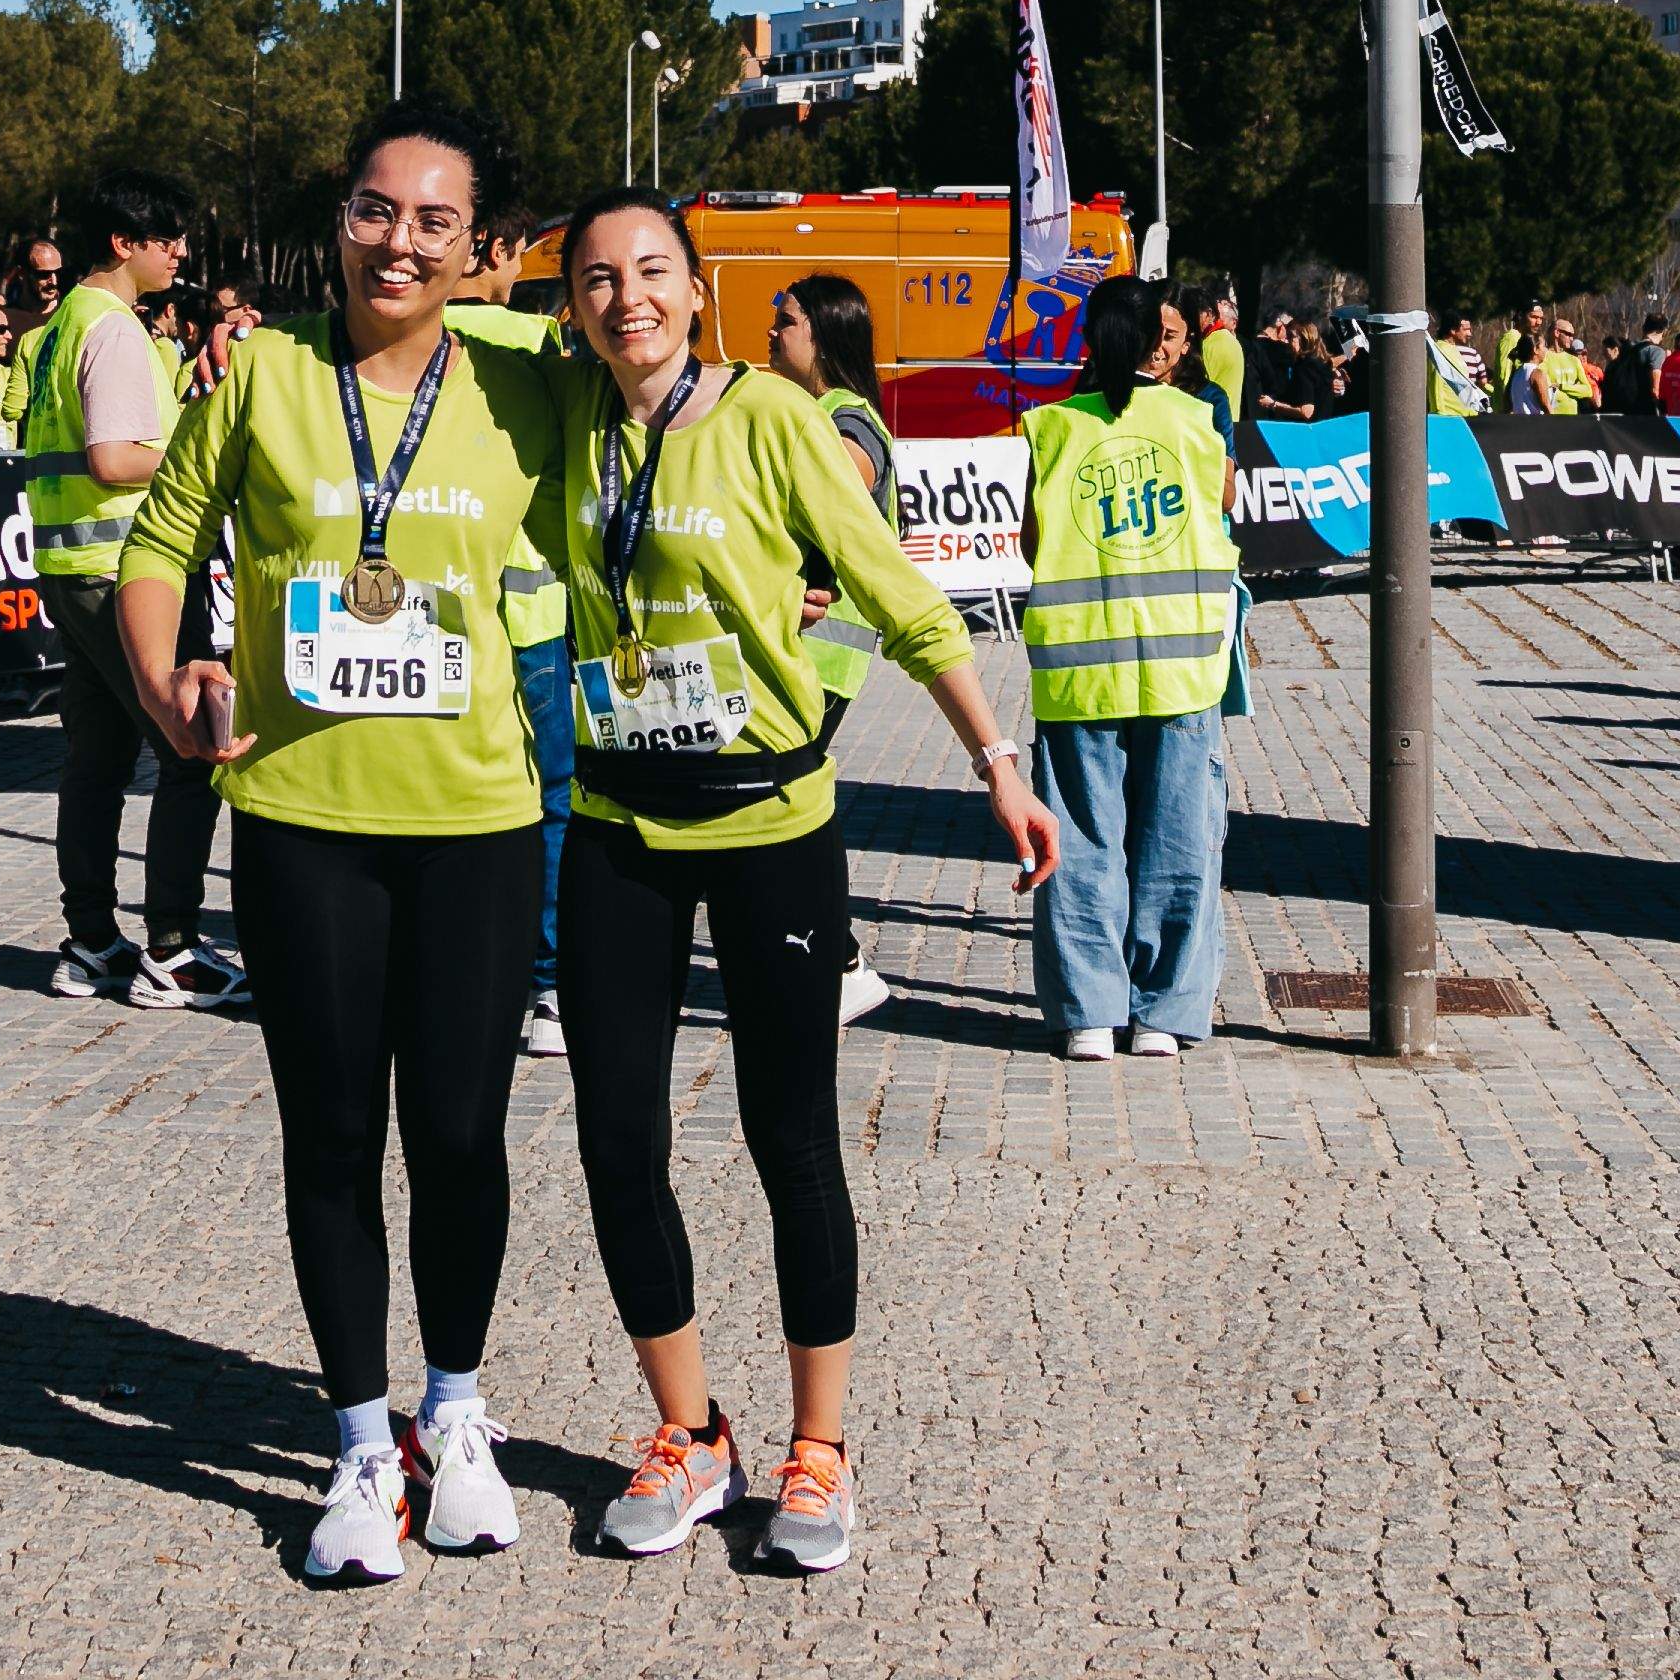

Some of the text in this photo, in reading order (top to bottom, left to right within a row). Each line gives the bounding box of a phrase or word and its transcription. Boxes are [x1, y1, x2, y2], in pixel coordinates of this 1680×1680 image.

[1078, 447, 1162, 499] Sport
[397, 486, 484, 520] etLife
[1098, 478, 1185, 539] Life
[939, 532, 1020, 560] SPORT
[633, 598, 686, 614] MADRID
[329, 657, 426, 699] 4756
